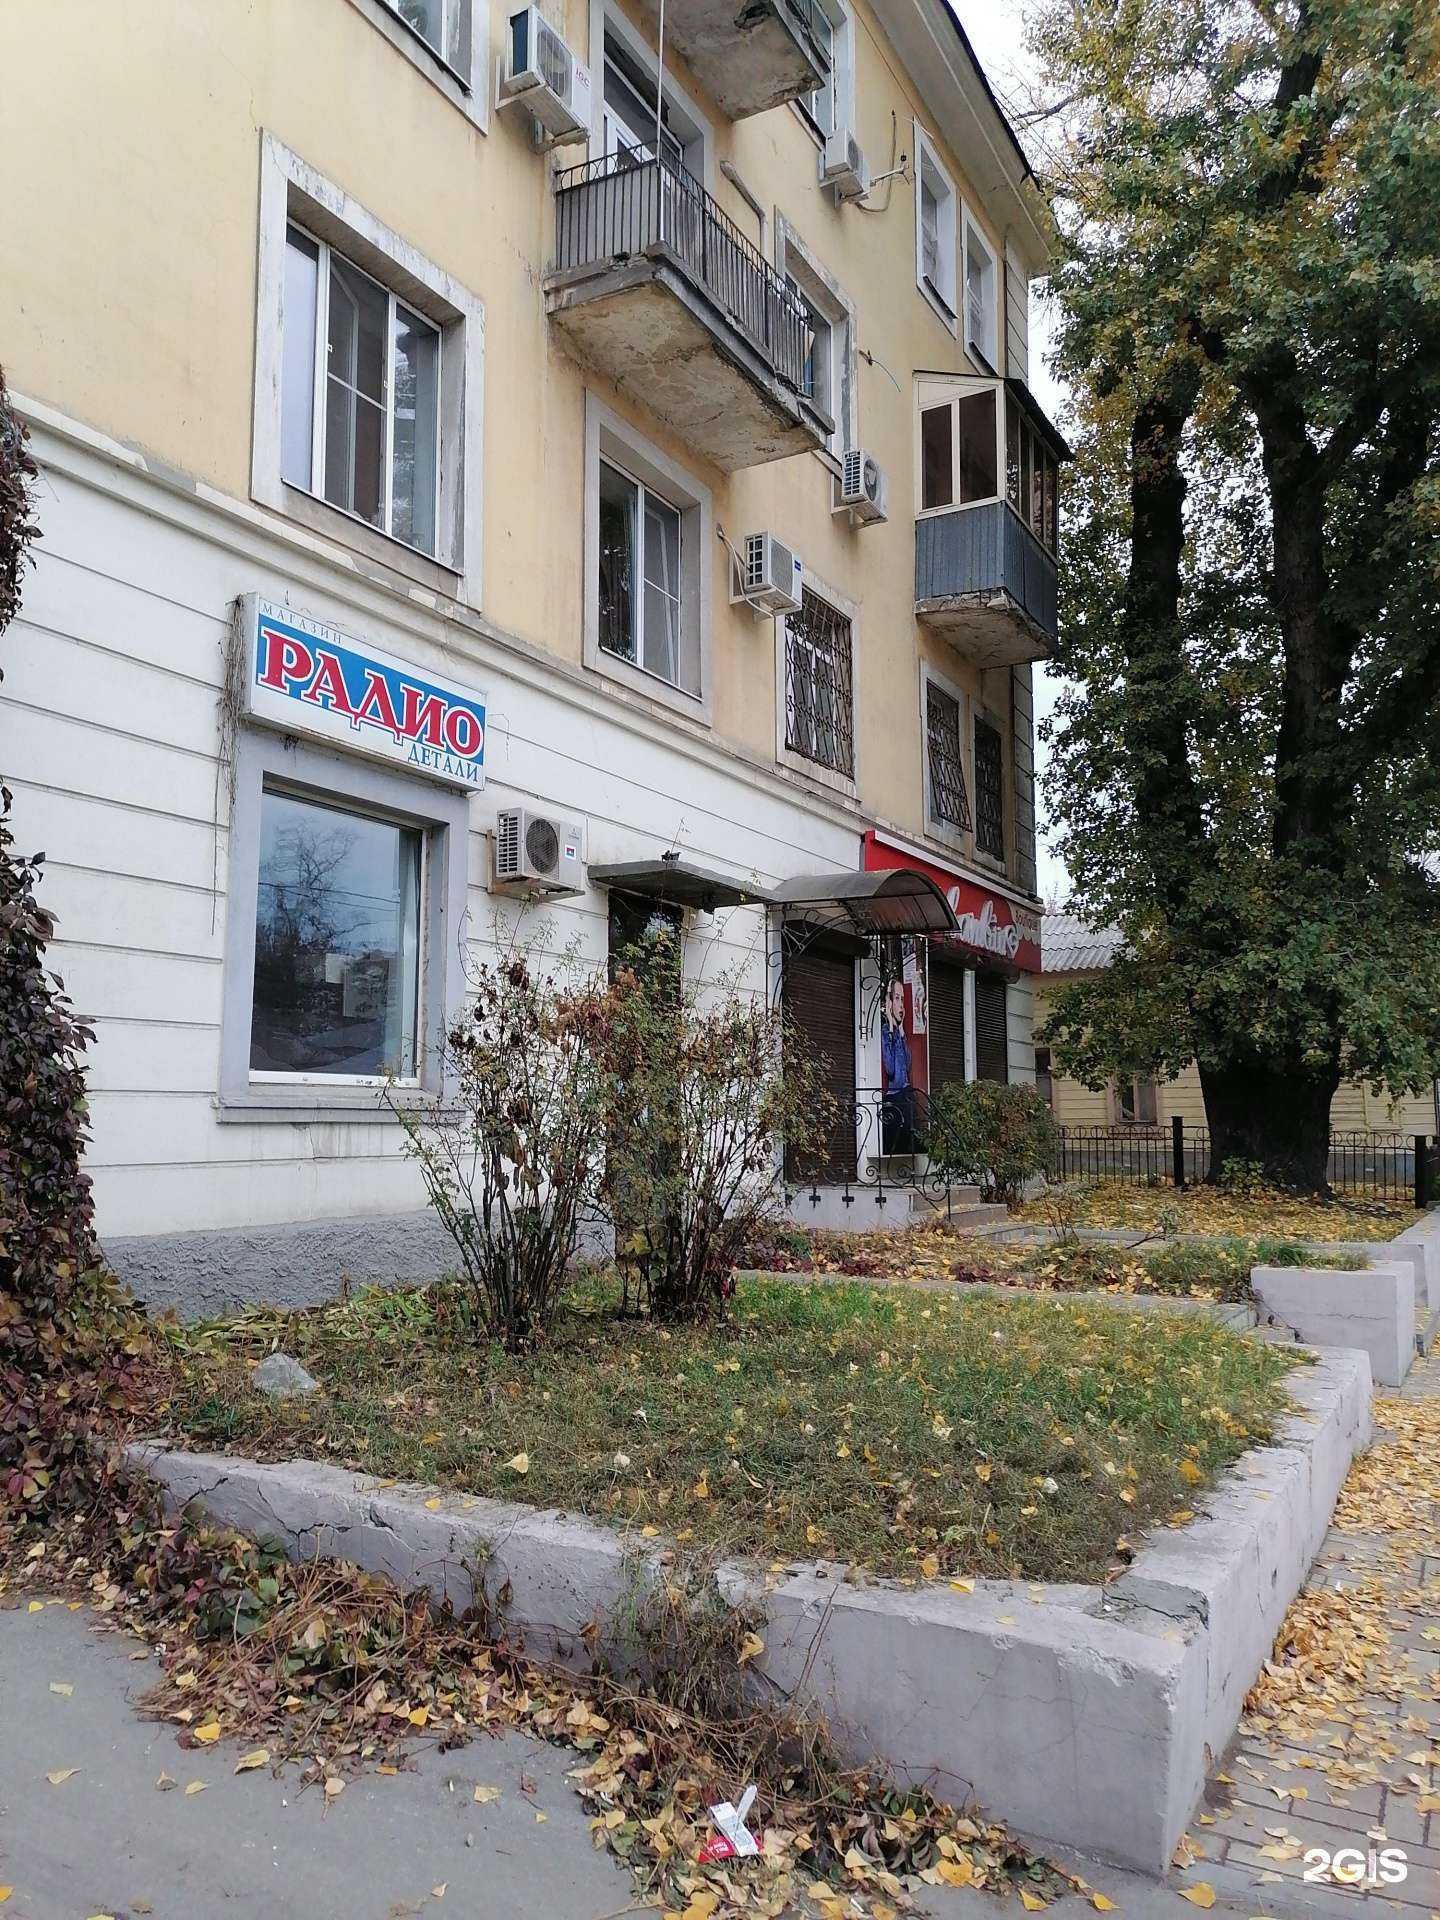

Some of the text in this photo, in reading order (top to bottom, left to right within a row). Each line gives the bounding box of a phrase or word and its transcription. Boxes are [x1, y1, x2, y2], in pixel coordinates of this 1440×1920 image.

[262, 602, 343, 644] МАГАЗИН
[259, 628, 483, 757] РАДИО
[407, 745, 480, 783] ДЕТАЛИ
